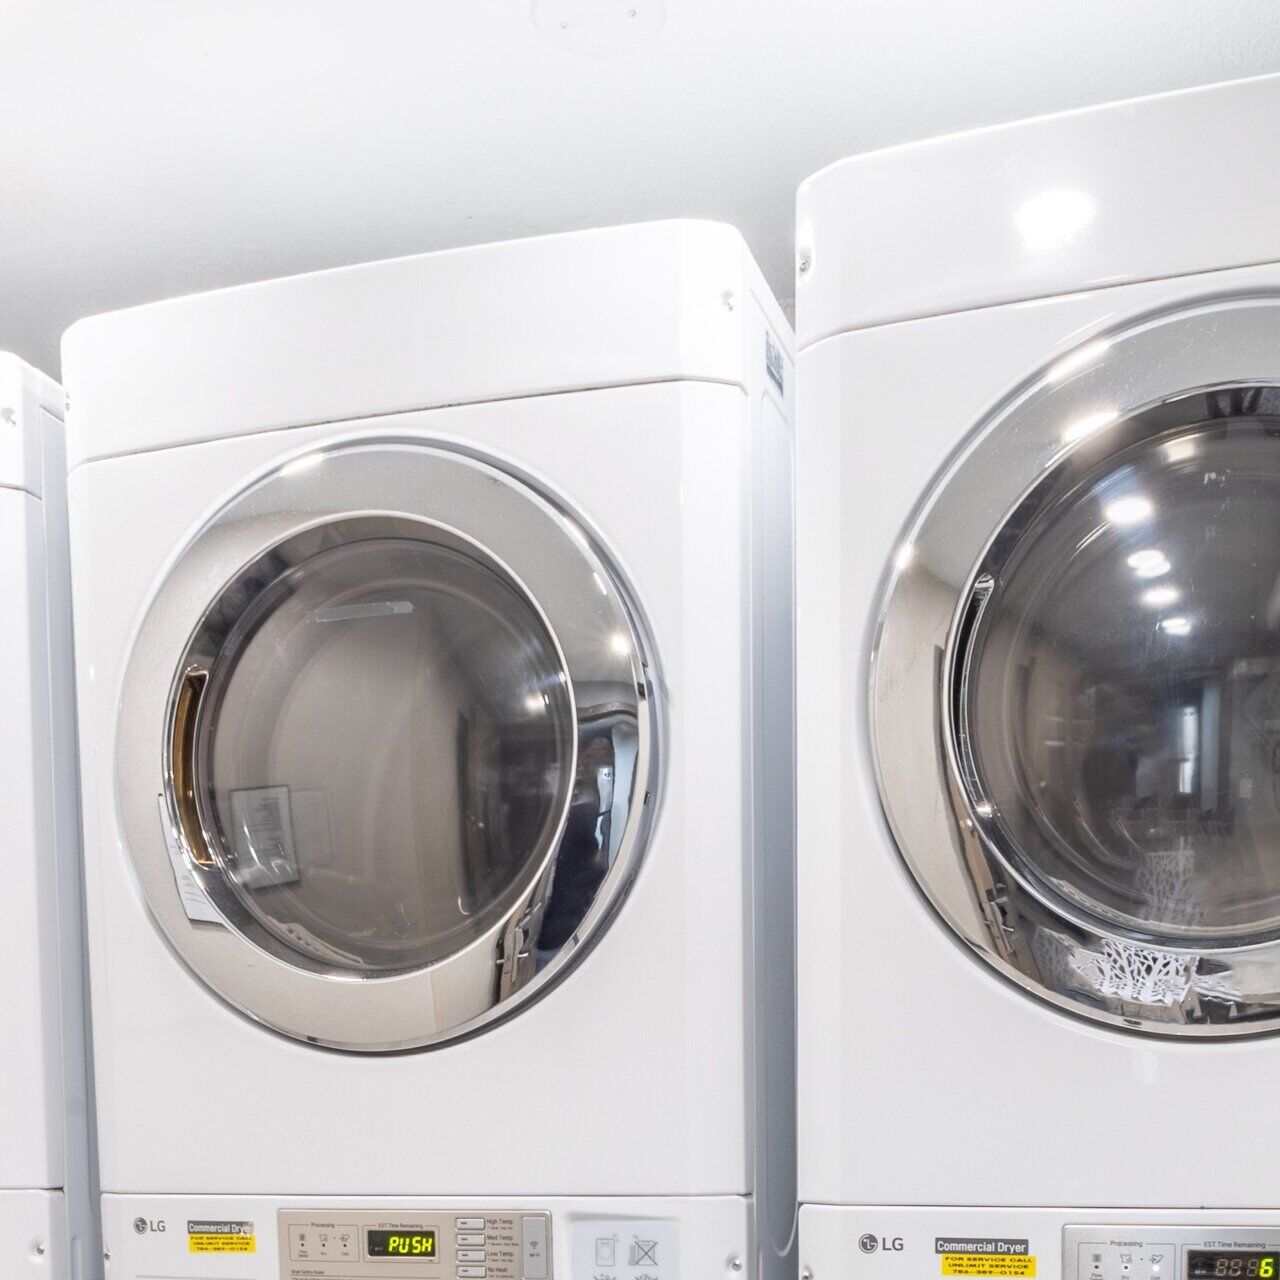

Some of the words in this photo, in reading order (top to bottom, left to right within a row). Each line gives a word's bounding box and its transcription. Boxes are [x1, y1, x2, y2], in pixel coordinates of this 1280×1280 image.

[150, 1220, 166, 1232] LG
[189, 1223, 230, 1232] Commercial
[388, 1236, 433, 1253] PUSH
[882, 1237, 904, 1251] LG
[937, 1240, 995, 1252] Commercial
[997, 1242, 1026, 1254] Dryer
[1110, 1240, 1143, 1248] Processing
